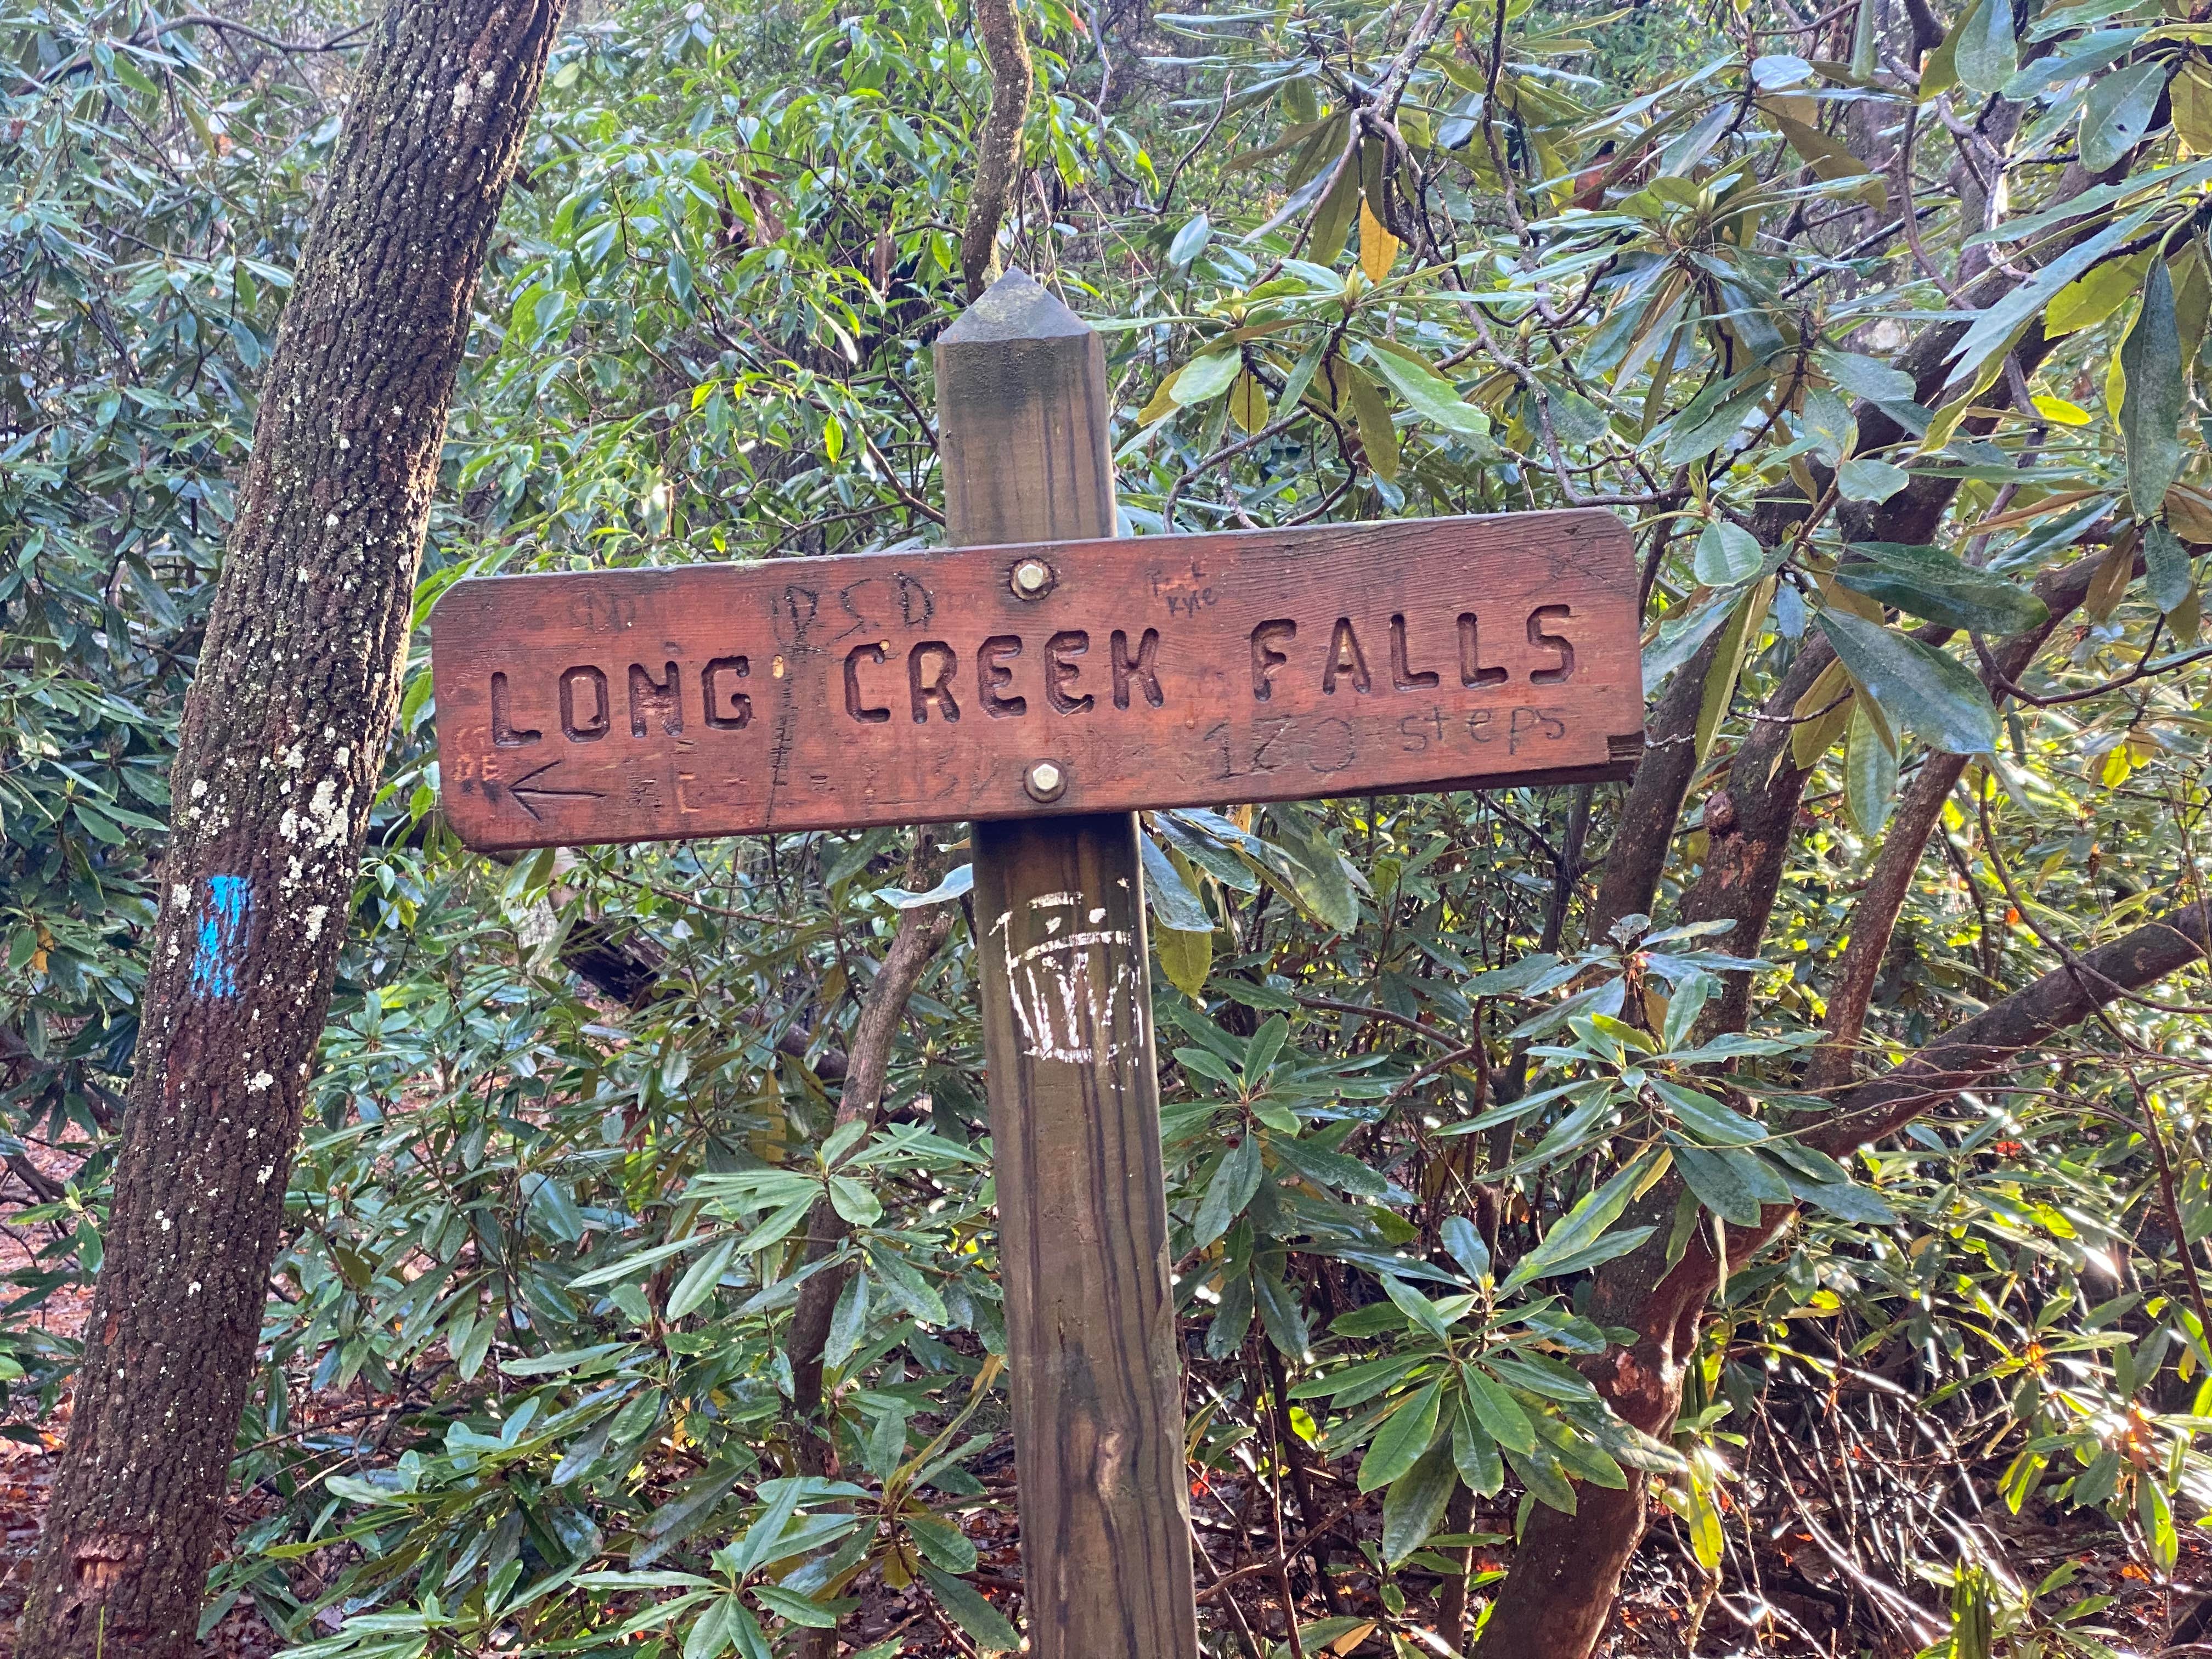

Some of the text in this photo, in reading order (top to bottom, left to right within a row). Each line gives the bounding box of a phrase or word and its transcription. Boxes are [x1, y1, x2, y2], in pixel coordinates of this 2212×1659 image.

[491, 603, 1575, 747] LONG CREEK FALLS
[1396, 707, 1565, 755] steps
